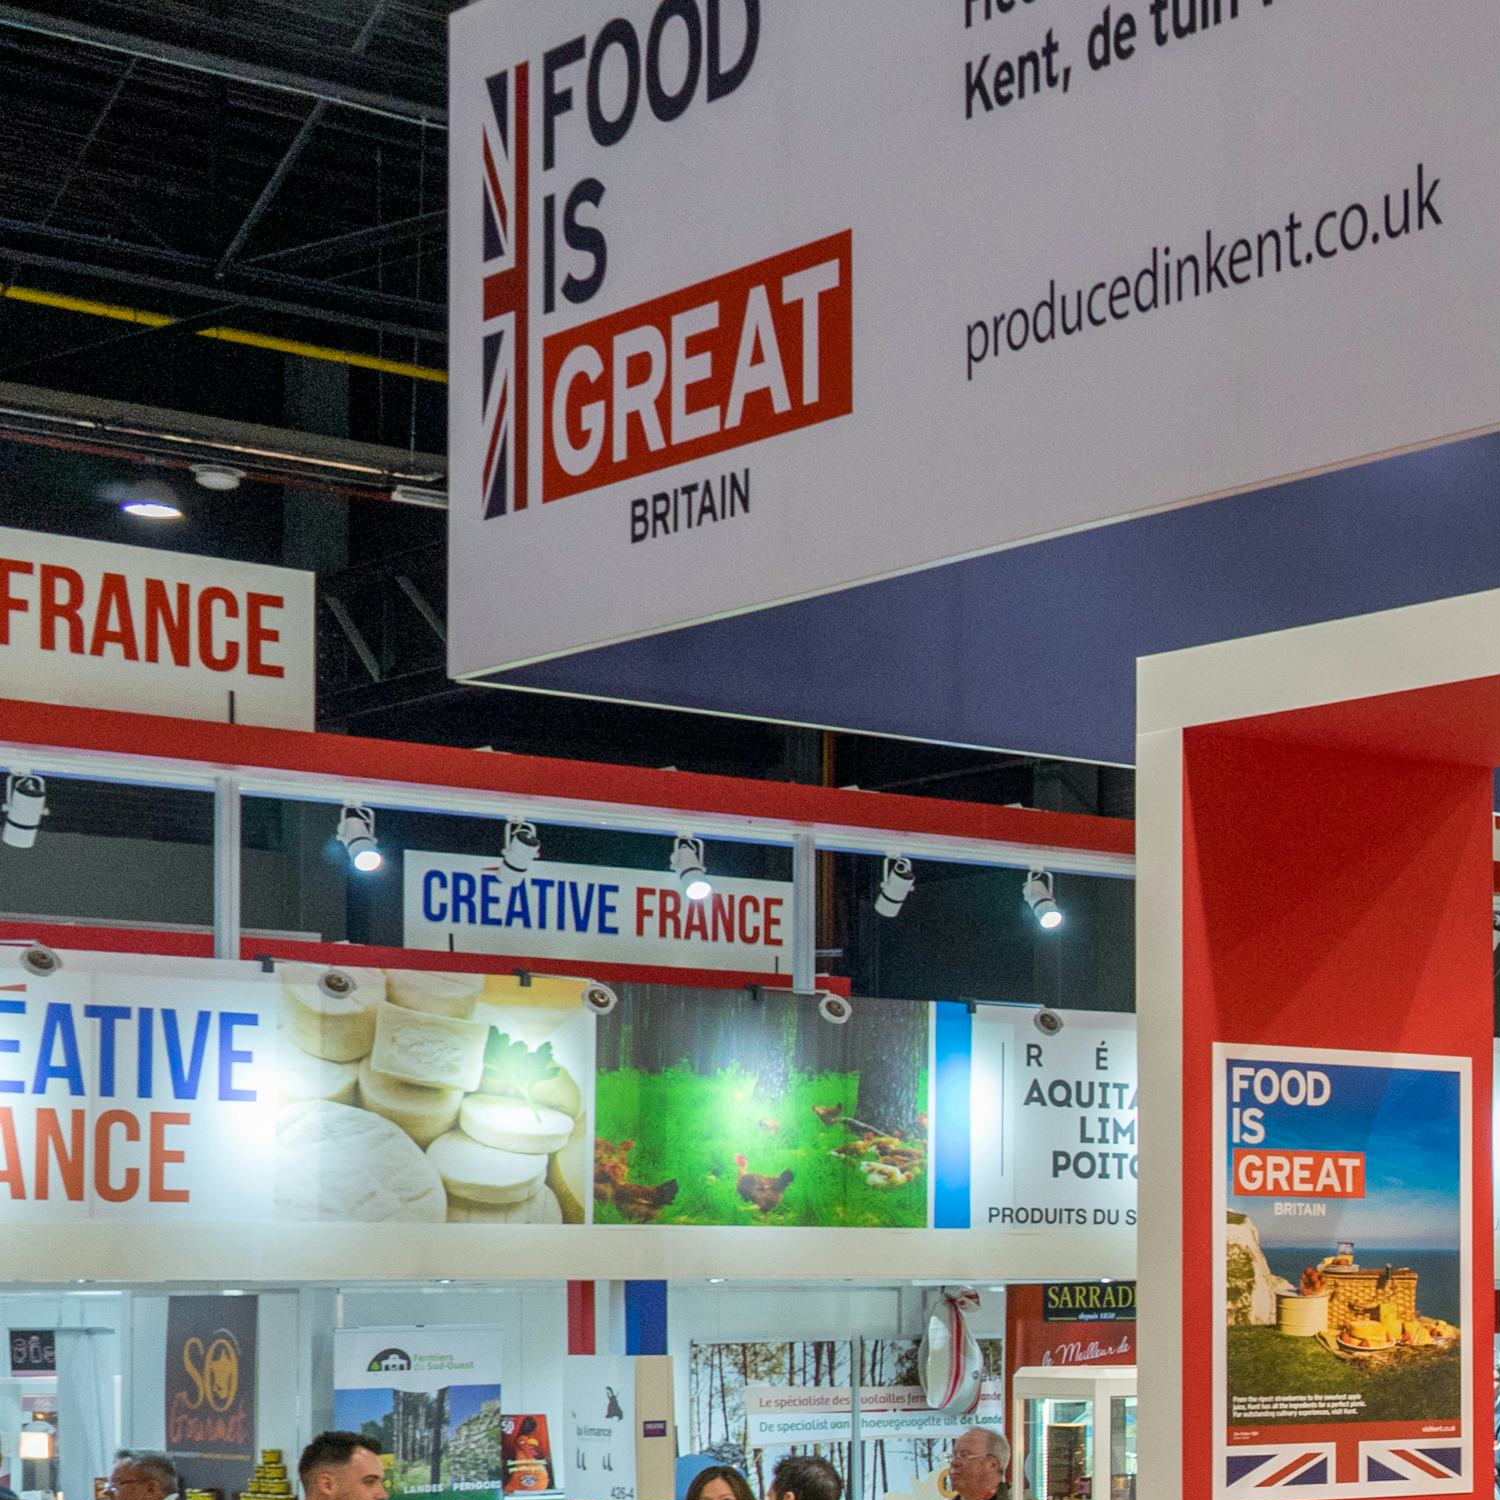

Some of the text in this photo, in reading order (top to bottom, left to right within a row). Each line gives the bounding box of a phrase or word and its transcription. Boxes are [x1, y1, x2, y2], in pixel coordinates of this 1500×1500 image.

[965, 27, 1071, 120] Kent,
[1087, 4, 1137, 71] de
[542, 0, 760, 172] FOOD
[541, 178, 608, 314] IS
[966, 165, 1443, 380] producedinkent.co.uk
[552, 259, 841, 477] GREAT
[630, 468, 751, 544] BRITAIN
[0, 558, 285, 678] FRANCE
[635, 887, 784, 947] FRANCE
[1232, 1067, 1332, 1107] FOOD
[1232, 1108, 1265, 1145] IS
[1238, 1154, 1361, 1193] GREAT
[988, 1207, 1088, 1224] PRODUITS
[1093, 1208, 1120, 1225] DU
[1273, 1201, 1327, 1217] BRITAIN
[413, 1353, 453, 1362] Fermiers
[427, 1361, 475, 1371] Sud-Ouest
[1056, 1341, 1115, 1364] Meilleur
[1117, 1336, 1130, 1355] de
[759, 1398, 771, 1407] Le
[774, 1396, 831, 1409] spécialiste
[832, 1396, 850, 1405] des
[861, 1393, 906, 1405] volailles
[760, 1422, 775, 1432] De
[777, 1420, 828, 1433] specialist
[831, 1420, 849, 1429] van
[944, 1417, 957, 1425] uit
[960, 1416, 973, 1425] de
[404, 1484, 443, 1494] LANDES
[611, 1487, 634, 1499] 426-4
